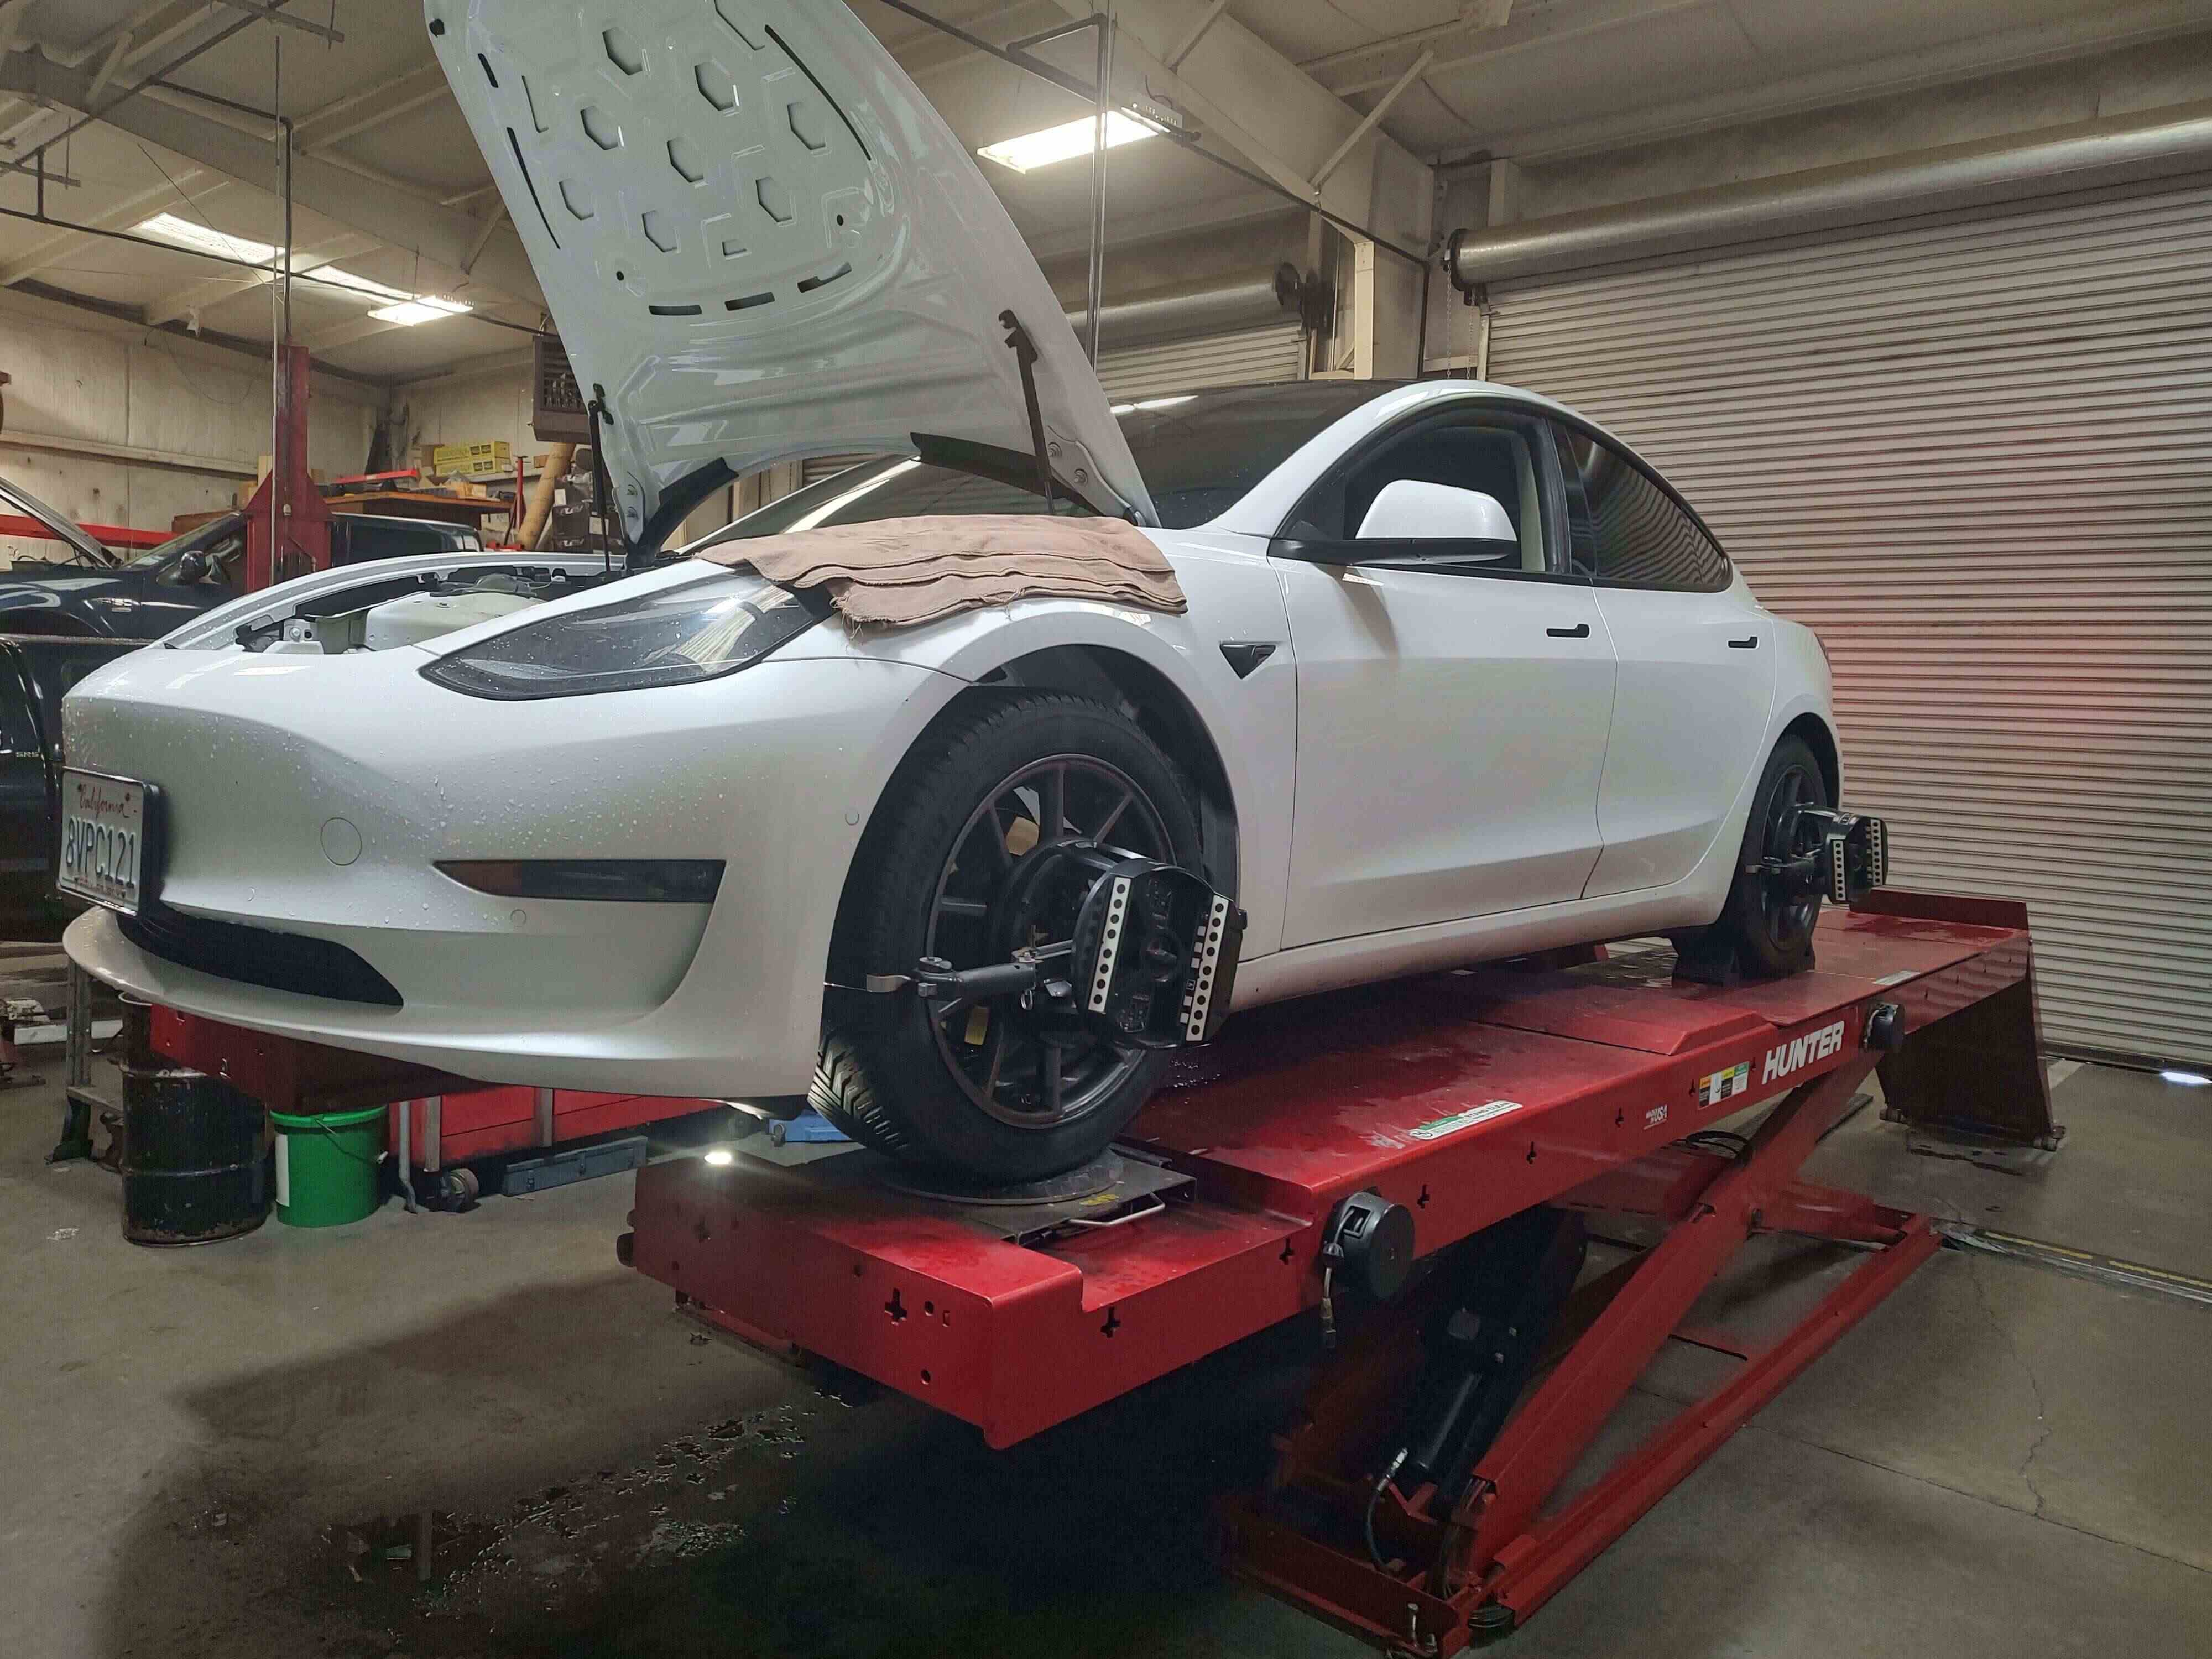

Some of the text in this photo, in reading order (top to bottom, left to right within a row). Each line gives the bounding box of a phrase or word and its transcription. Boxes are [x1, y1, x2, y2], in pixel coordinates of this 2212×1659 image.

[79, 783, 129, 818] California
[66, 817, 134, 888] 8VPC121
[1761, 1020, 1844, 1084] HUNTER
